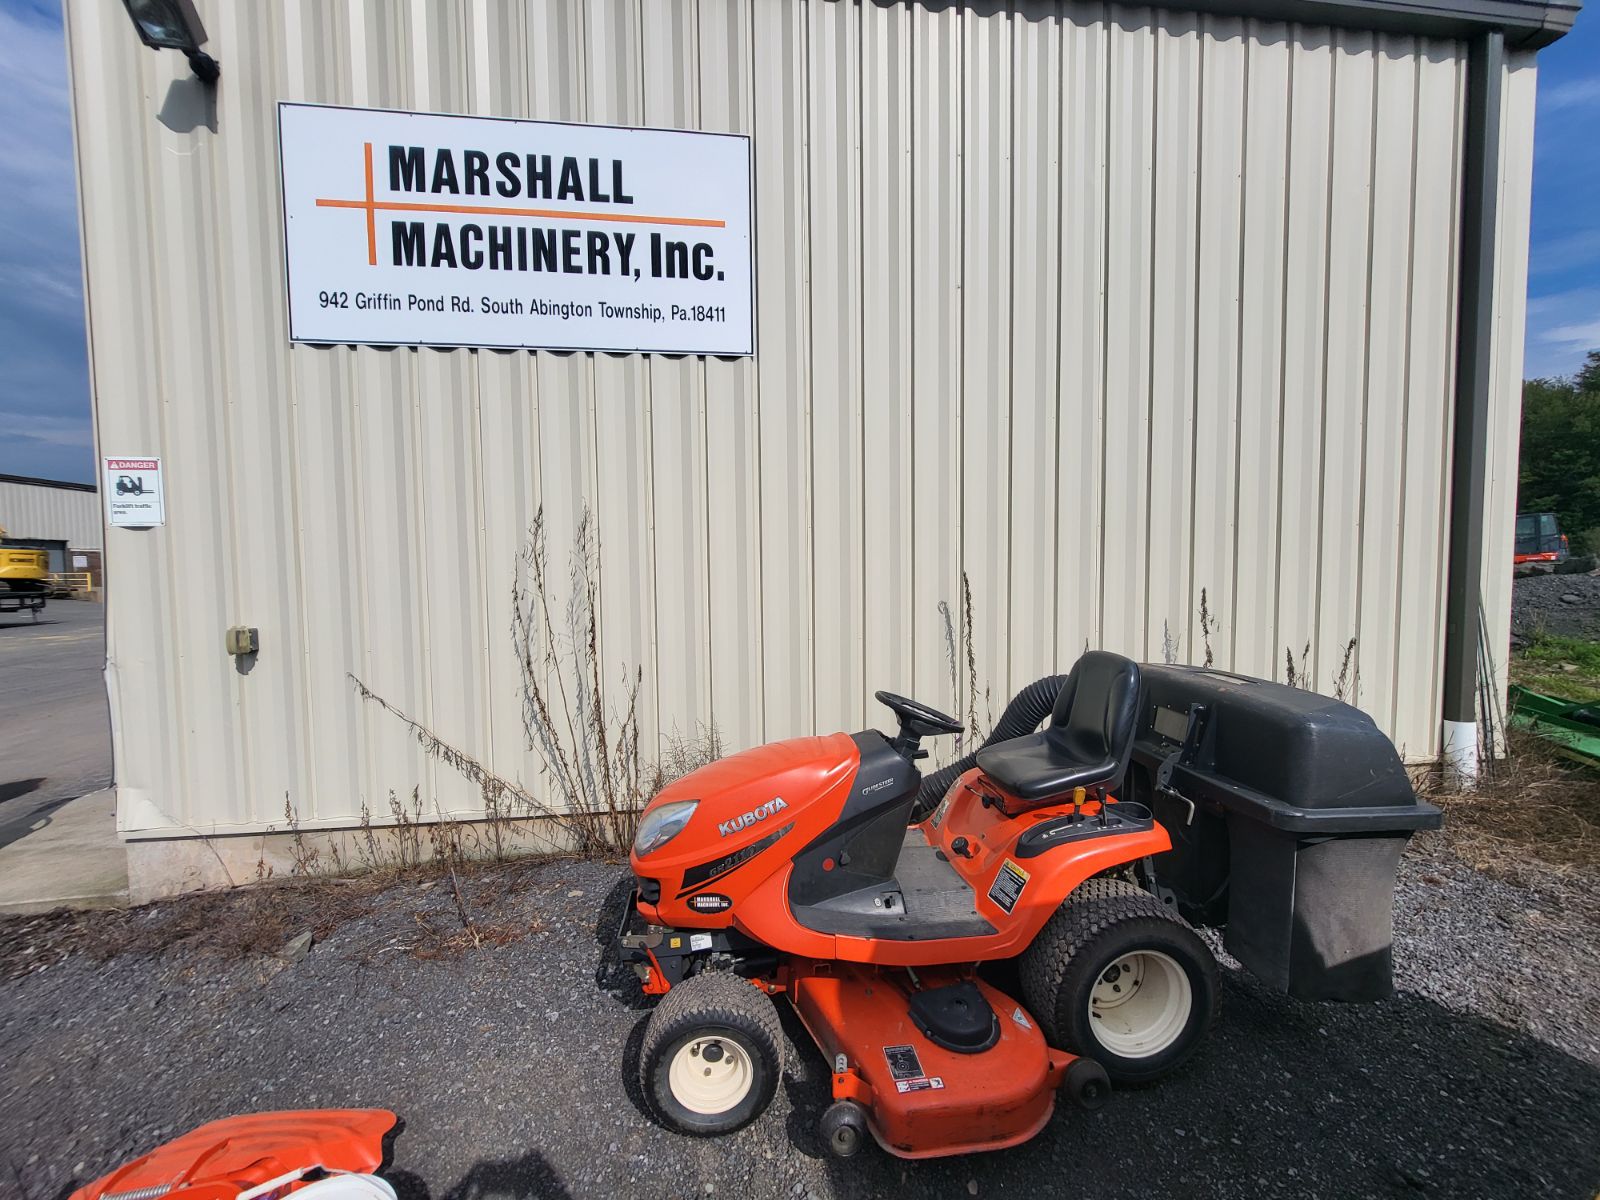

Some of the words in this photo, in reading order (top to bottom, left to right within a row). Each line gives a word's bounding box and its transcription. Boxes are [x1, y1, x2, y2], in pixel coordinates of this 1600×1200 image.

[388, 145, 634, 204] MARSHALL
[391, 221, 641, 282] MACHINERY,
[650, 232, 725, 281] Inc.
[319, 291, 349, 309] 942
[355, 292, 401, 311] Griffin
[408, 294, 445, 313] Pond
[450, 296, 475, 314] Rd.
[481, 297, 524, 316] South
[530, 298, 593, 322] Abington
[598, 301, 666, 323] Township,
[718, 796, 789, 836] KUBOTA
